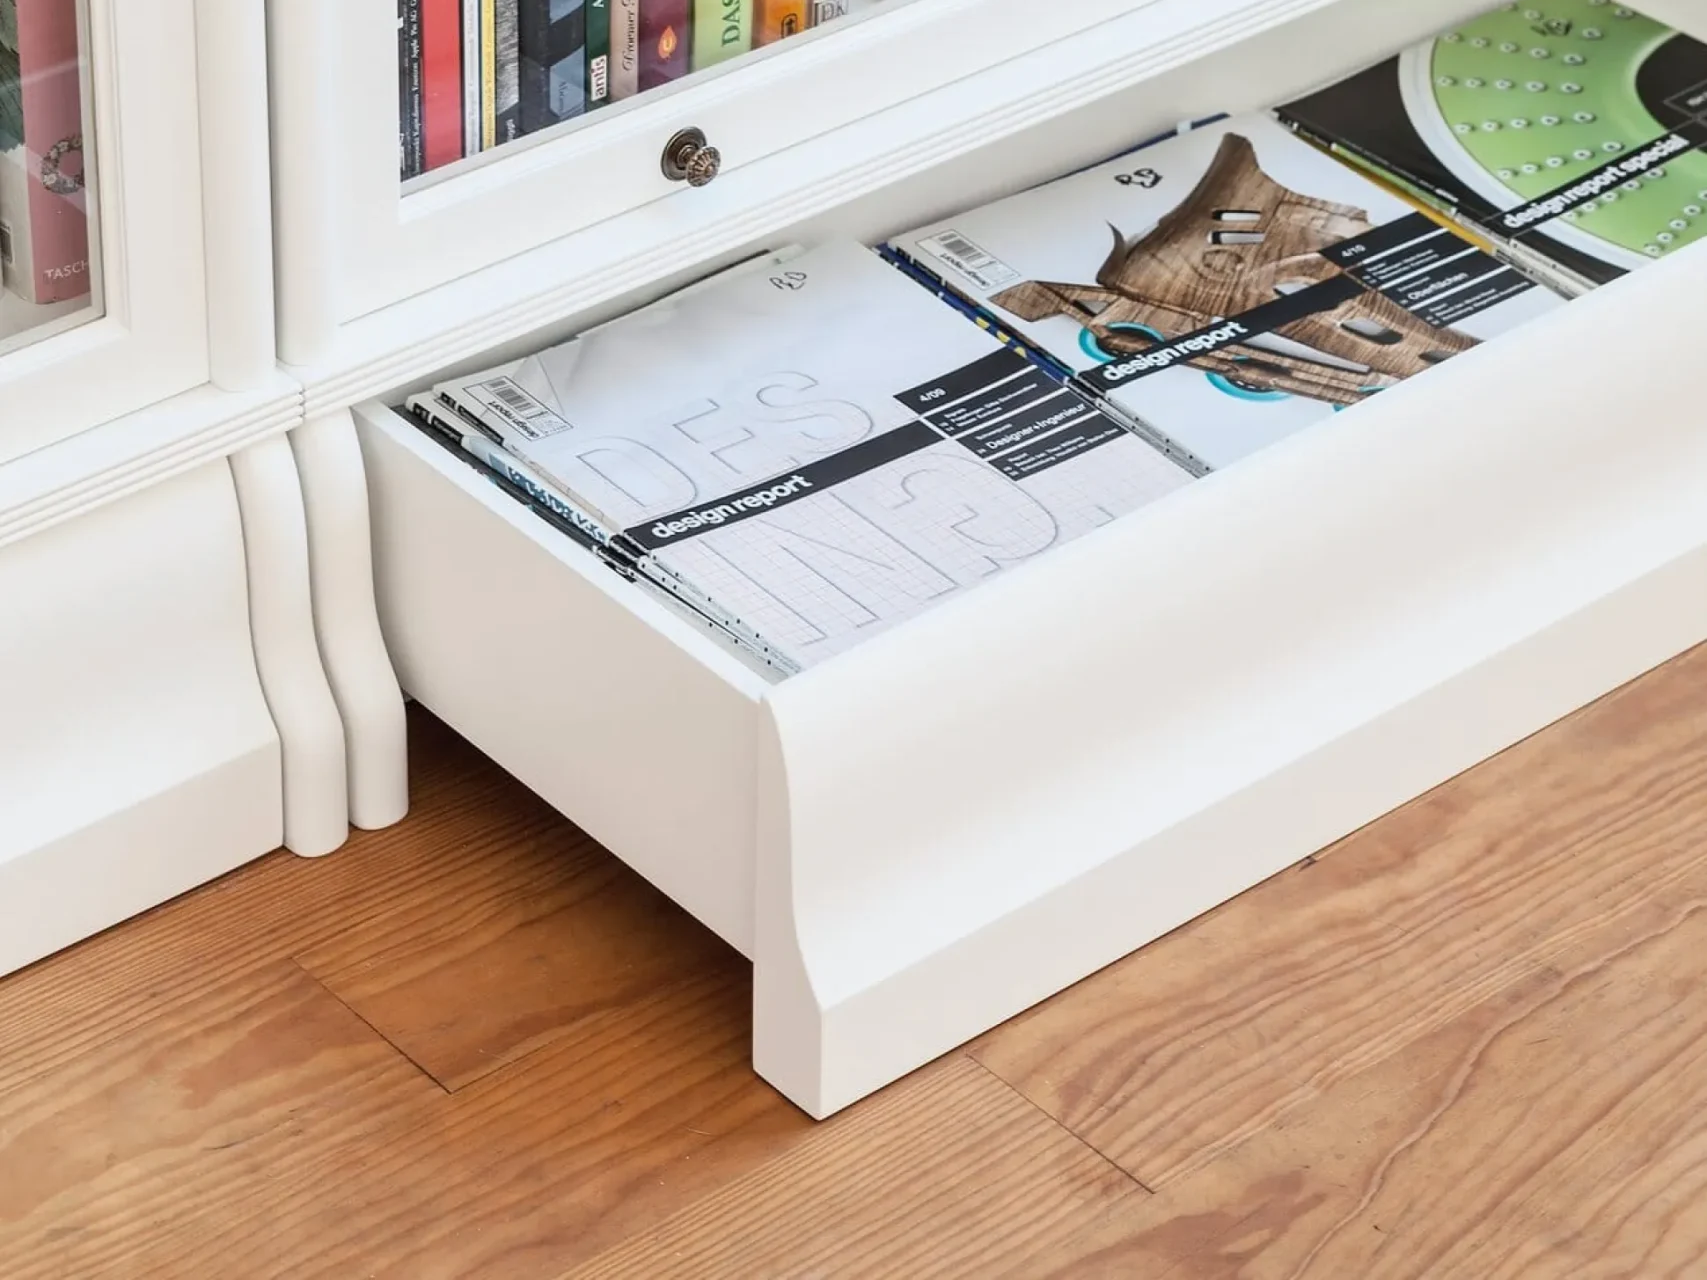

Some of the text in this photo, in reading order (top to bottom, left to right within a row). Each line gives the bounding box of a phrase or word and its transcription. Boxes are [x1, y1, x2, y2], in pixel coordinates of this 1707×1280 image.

[1503, 133, 1690, 228] design report special
[1102, 321, 1249, 382] design report
[651, 474, 814, 539] design report
